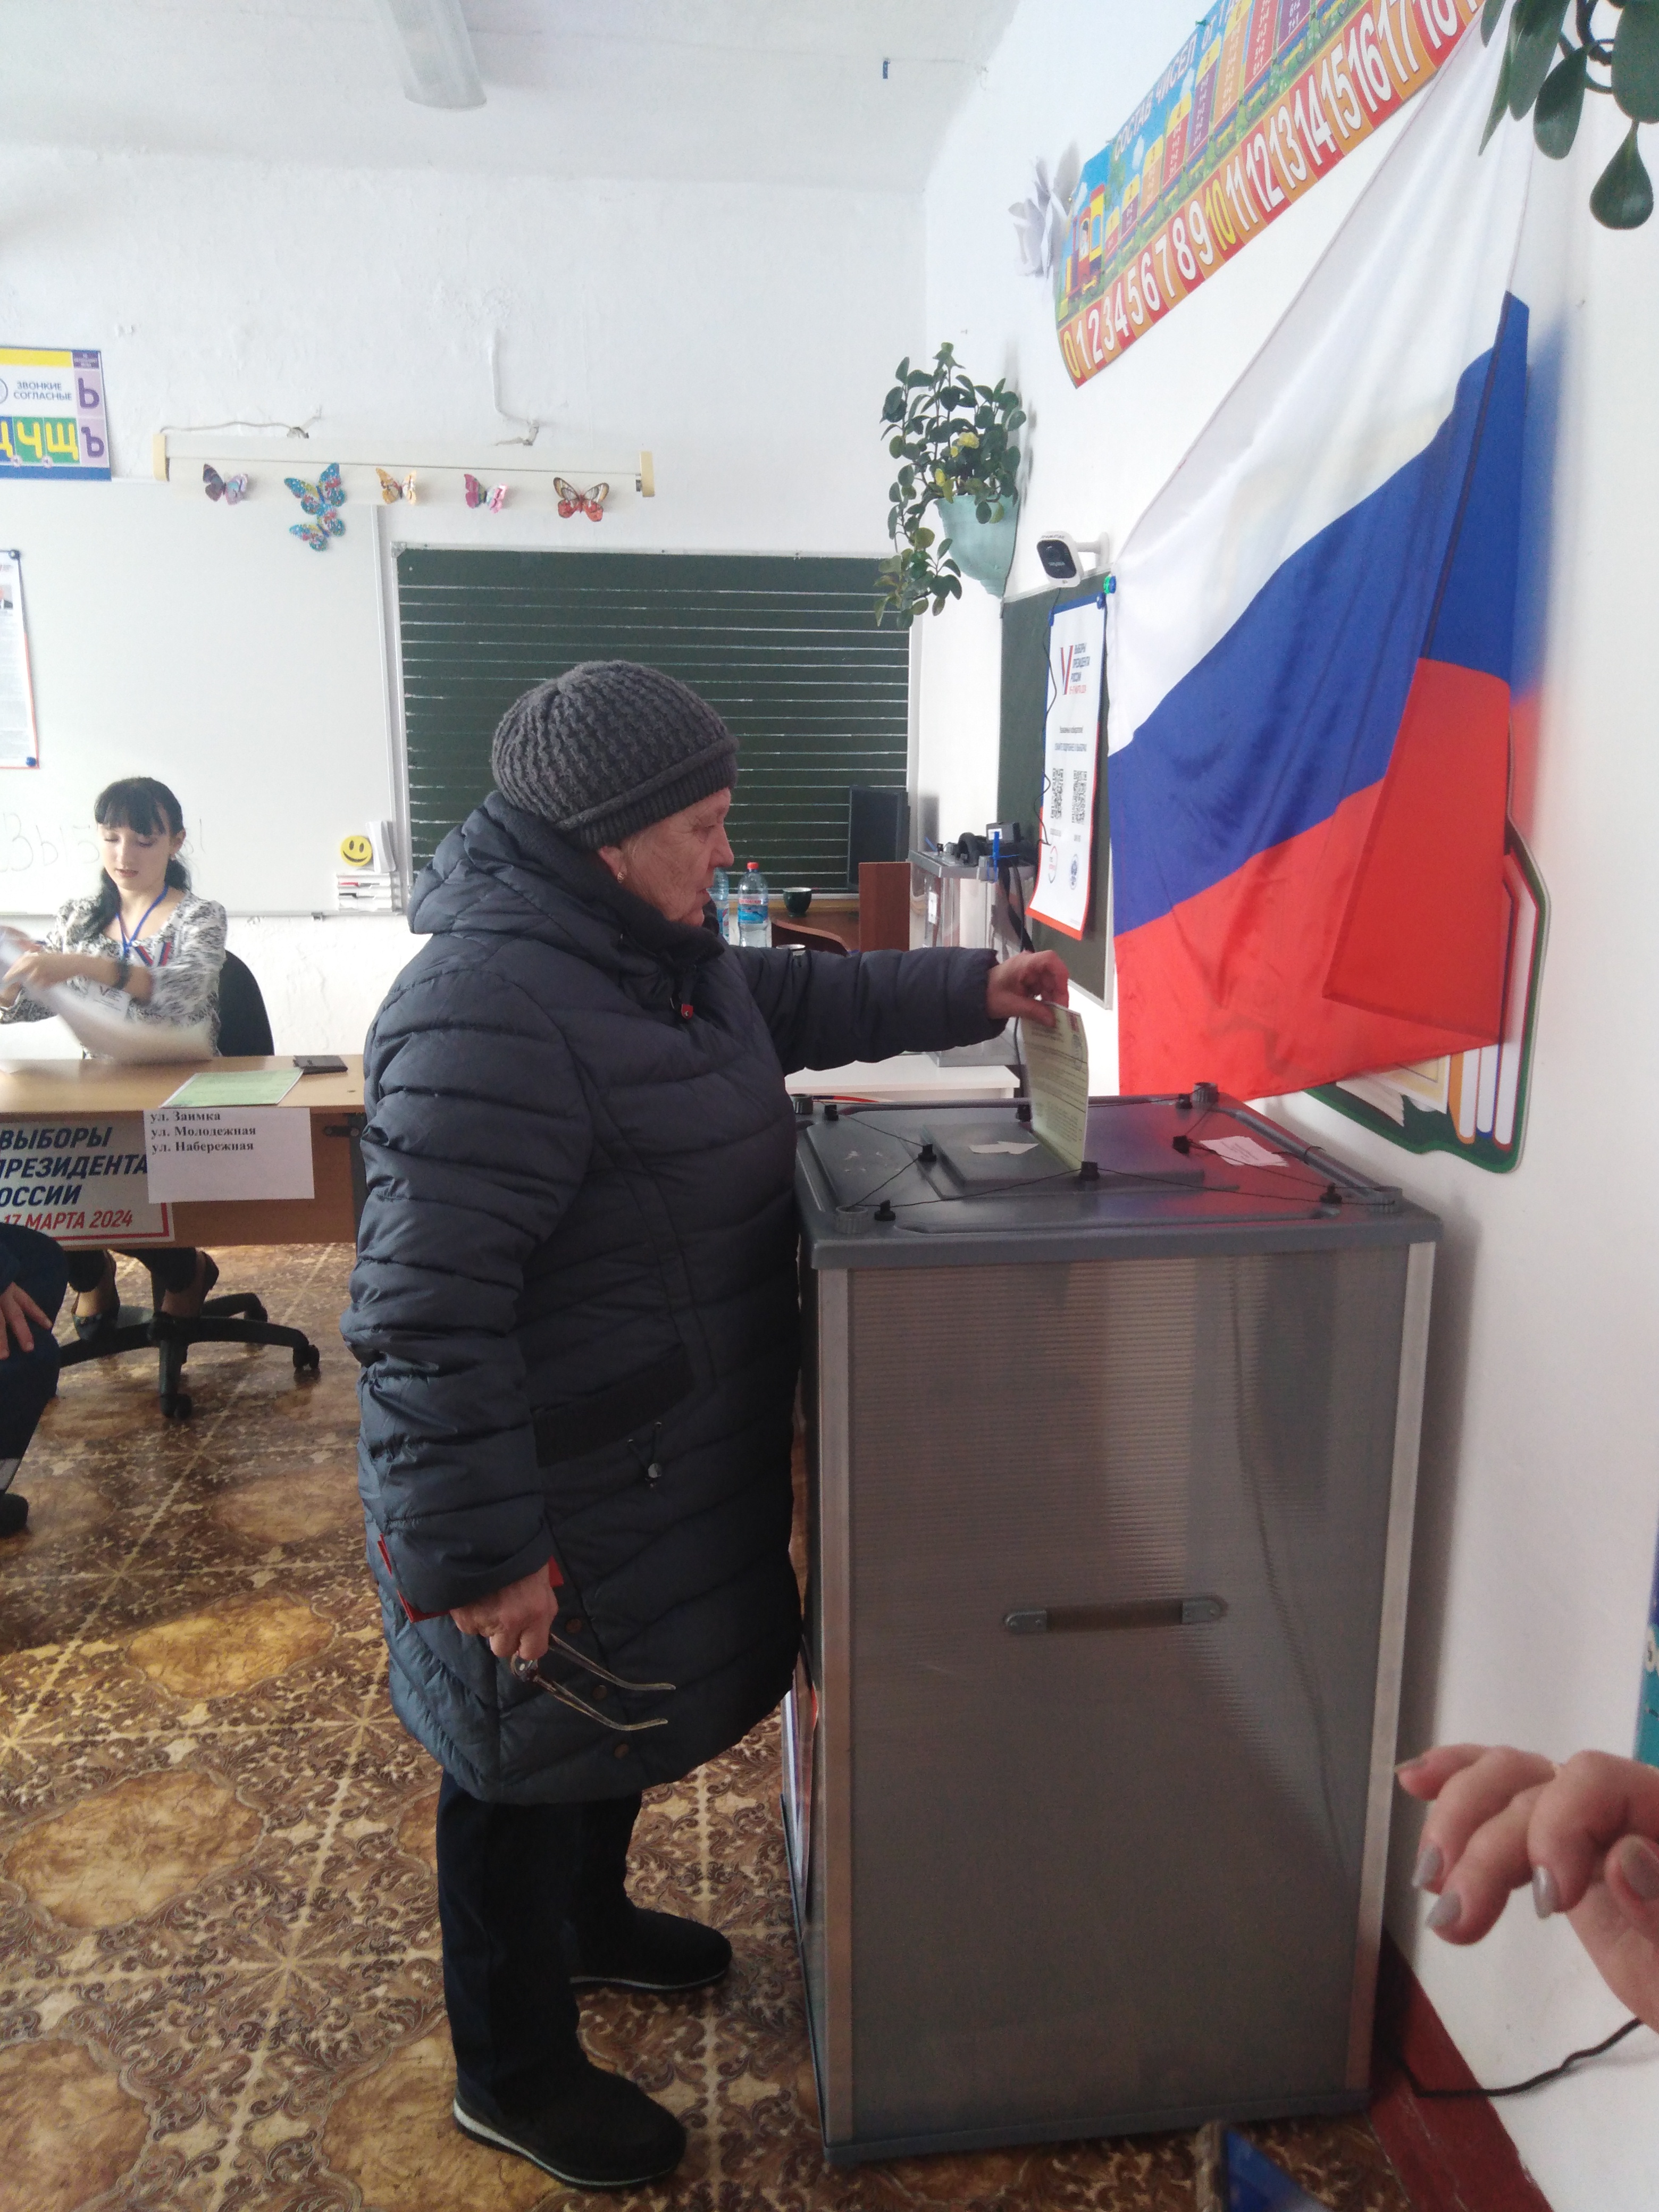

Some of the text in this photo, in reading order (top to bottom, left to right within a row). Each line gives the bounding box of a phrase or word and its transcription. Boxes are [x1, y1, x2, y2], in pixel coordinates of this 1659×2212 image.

[1064, 331, 1080, 379] 0
[1076, 320, 1091, 369] 1
[1088, 308, 1104, 364] 2
[1103, 296, 1115, 351] 3
[1115, 282, 1129, 337] 4
[1128, 266, 1143, 325] 5
[1141, 252, 1160, 311] 6
[1155, 234, 1175, 298] 7
[1172, 217, 1196, 280] 8
[1189, 200, 1213, 265] 9
[1205, 179, 1236, 251] 10
[1226, 155, 1259, 231] 11
[1246, 133, 1285, 213] 12
[1269, 106, 1307, 190] 13
[1294, 74, 1336, 166] 14
[1321, 42, 1362, 139] 15
[1348, 12, 1392, 113] 16
[1378, 0, 1420, 84] 17
[17, 381, 62, 391] ЗВОНКИЕ
[14, 391, 72, 400] СОГЛАСНЫЕ
[150, 1111, 221, 1124] ул. Заимка
[0, 1126, 113, 1151] ВЫБОРЫ
[151, 1126, 256, 1139] ул. Молодежная
[152, 1142, 254, 1155] ул. Набережная
[25, 1211, 85, 1230] МАРТА
[89, 1209, 133, 1228] 2024
